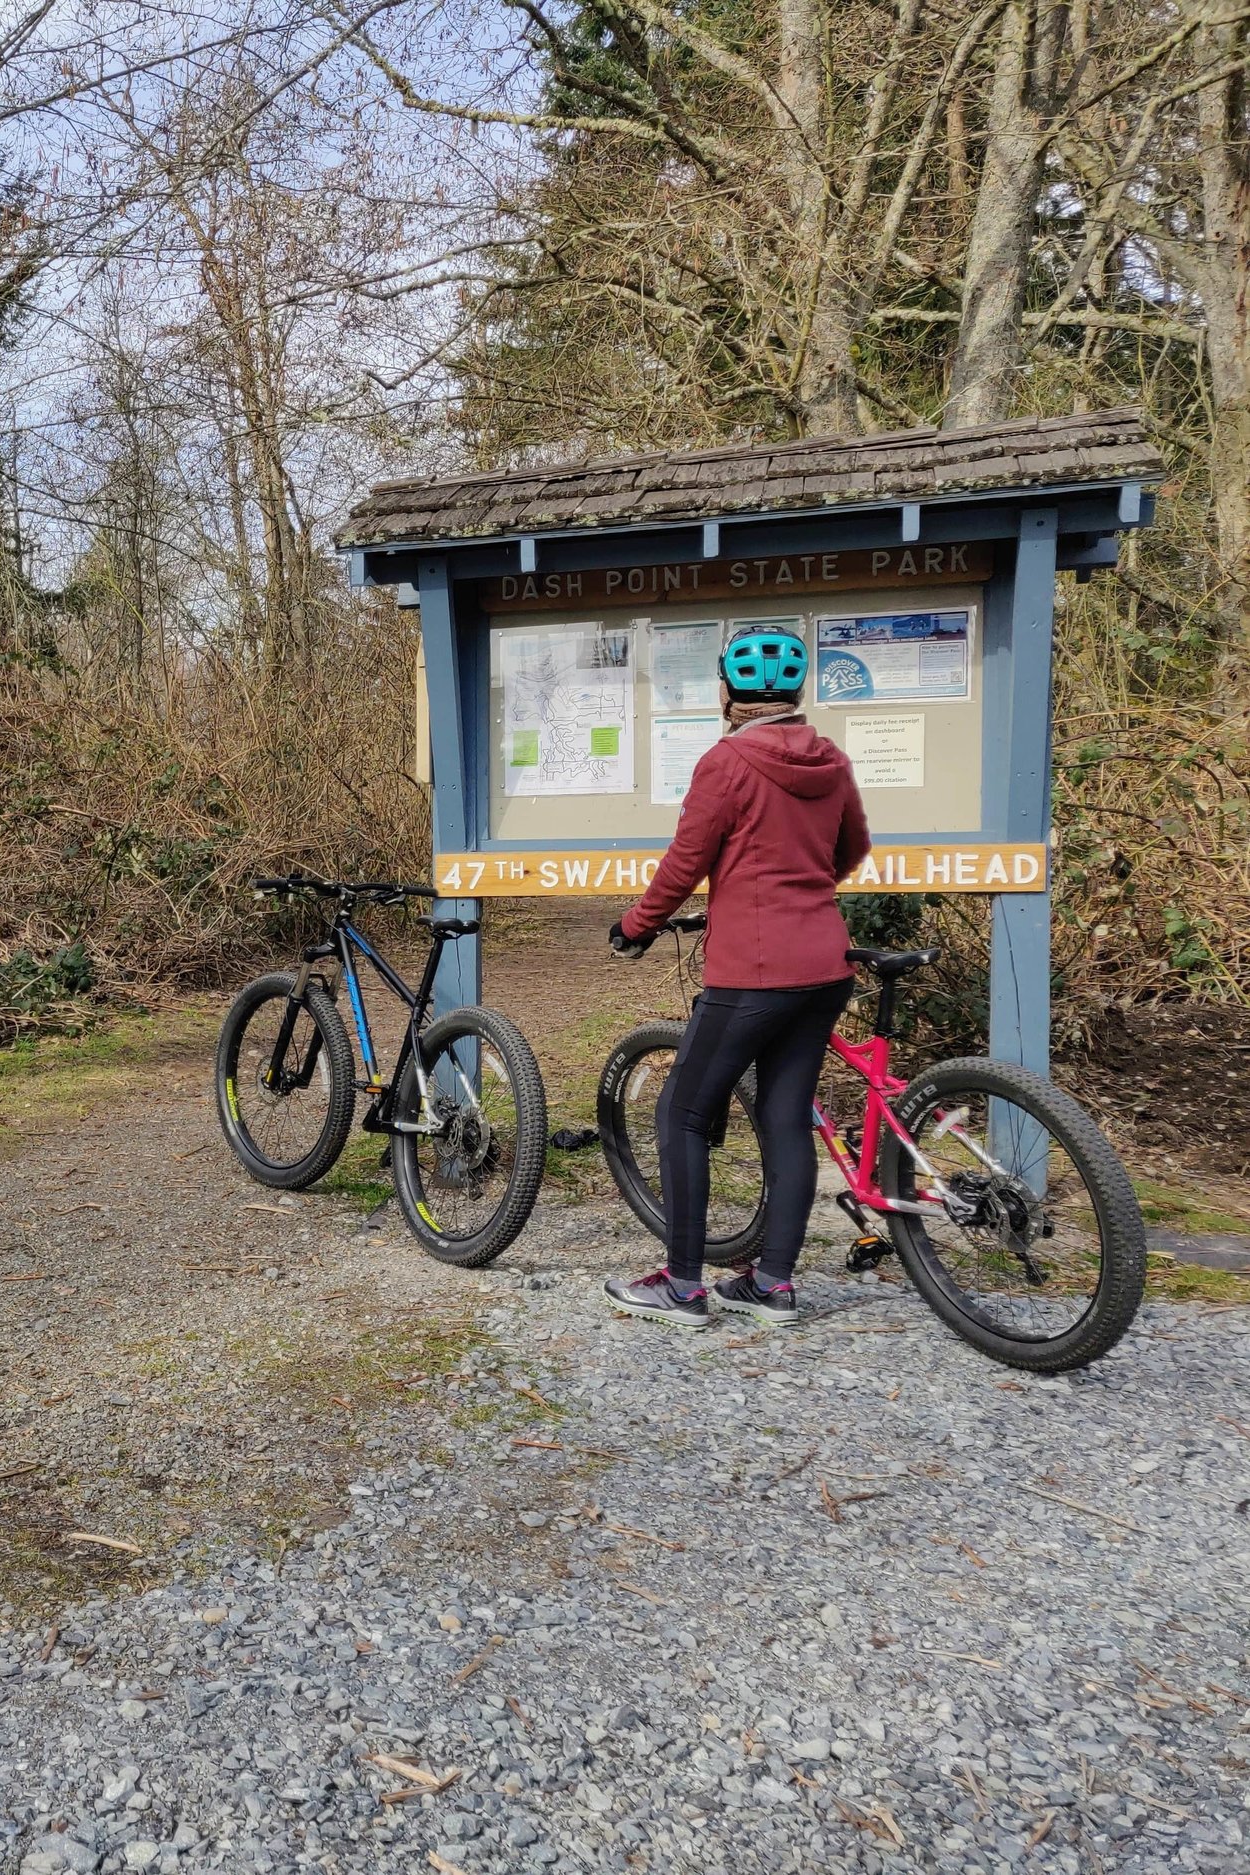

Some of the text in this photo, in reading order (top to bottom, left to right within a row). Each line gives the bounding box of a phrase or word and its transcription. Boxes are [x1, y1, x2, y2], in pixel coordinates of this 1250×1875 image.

[502, 544, 969, 600] DASH POINT STATE PARK
[822, 671, 863, 687] PASS
[825, 659, 860, 673] DISCOVER
[539, 858, 660, 889] SW/HO
[845, 852, 1040, 885] AILHEAD
[900, 1084, 938, 1120] WTB
